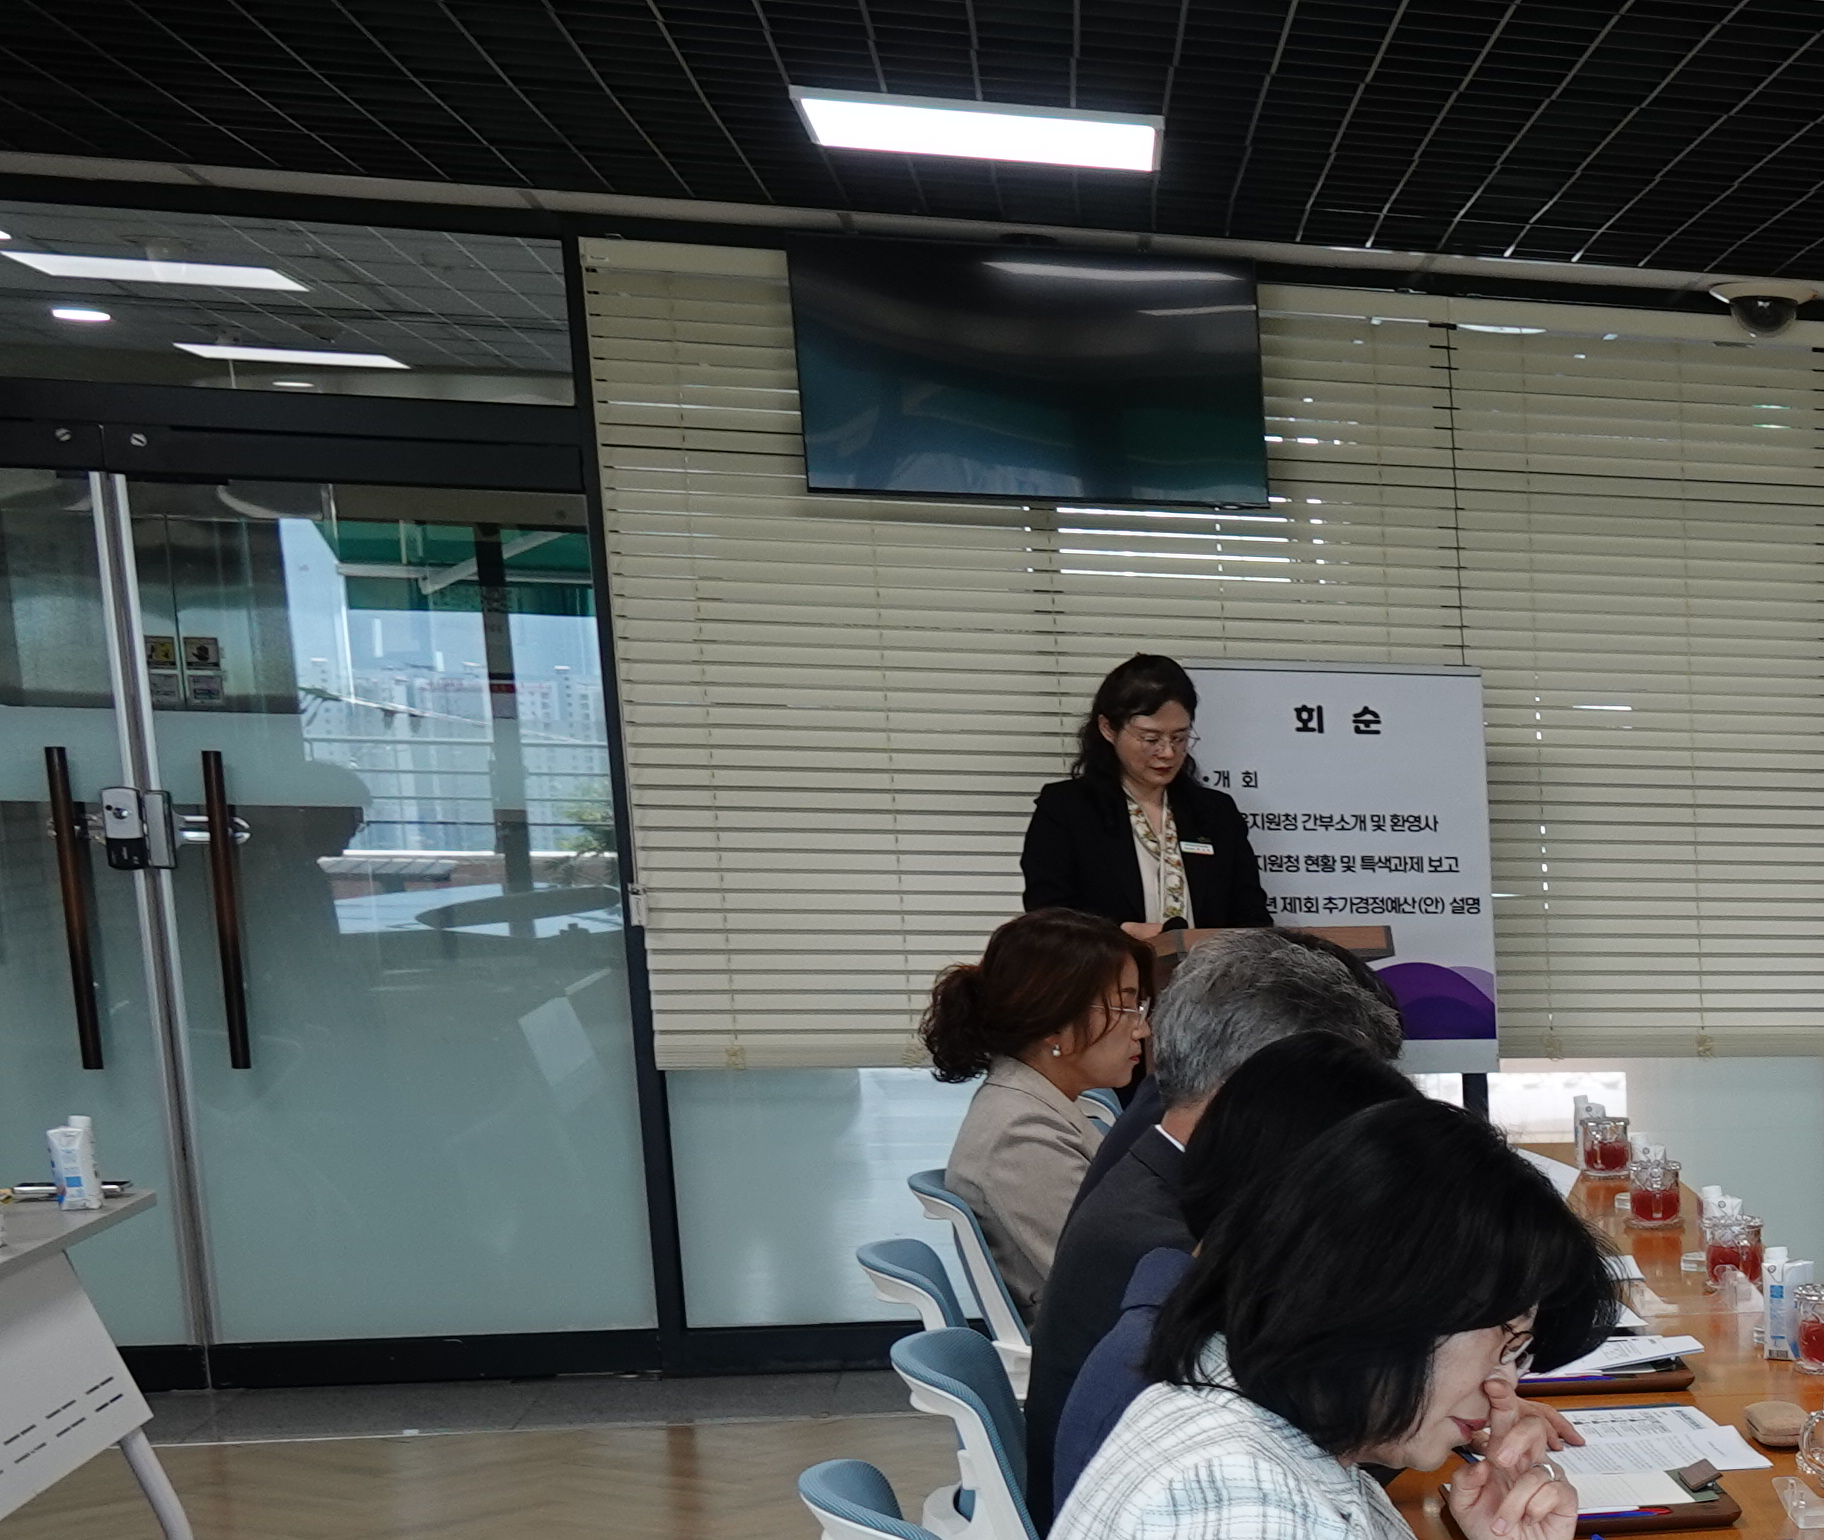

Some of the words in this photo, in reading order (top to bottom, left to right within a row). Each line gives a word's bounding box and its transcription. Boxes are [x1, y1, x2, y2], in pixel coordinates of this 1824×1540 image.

[1302, 813, 1366, 832] 간부소개
[1370, 814, 1387, 832] 및
[1390, 813, 1439, 833] 환영사
[1304, 854, 1337, 873] 현황
[1340, 855, 1356, 873] 및
[1360, 855, 1424, 874] 특색과제
[1427, 856, 1460, 873] 보고
[1281, 896, 1320, 914] 제1회
[1323, 896, 1446, 915] 추가경정예산(안)
[1450, 896, 1481, 915] 설명
